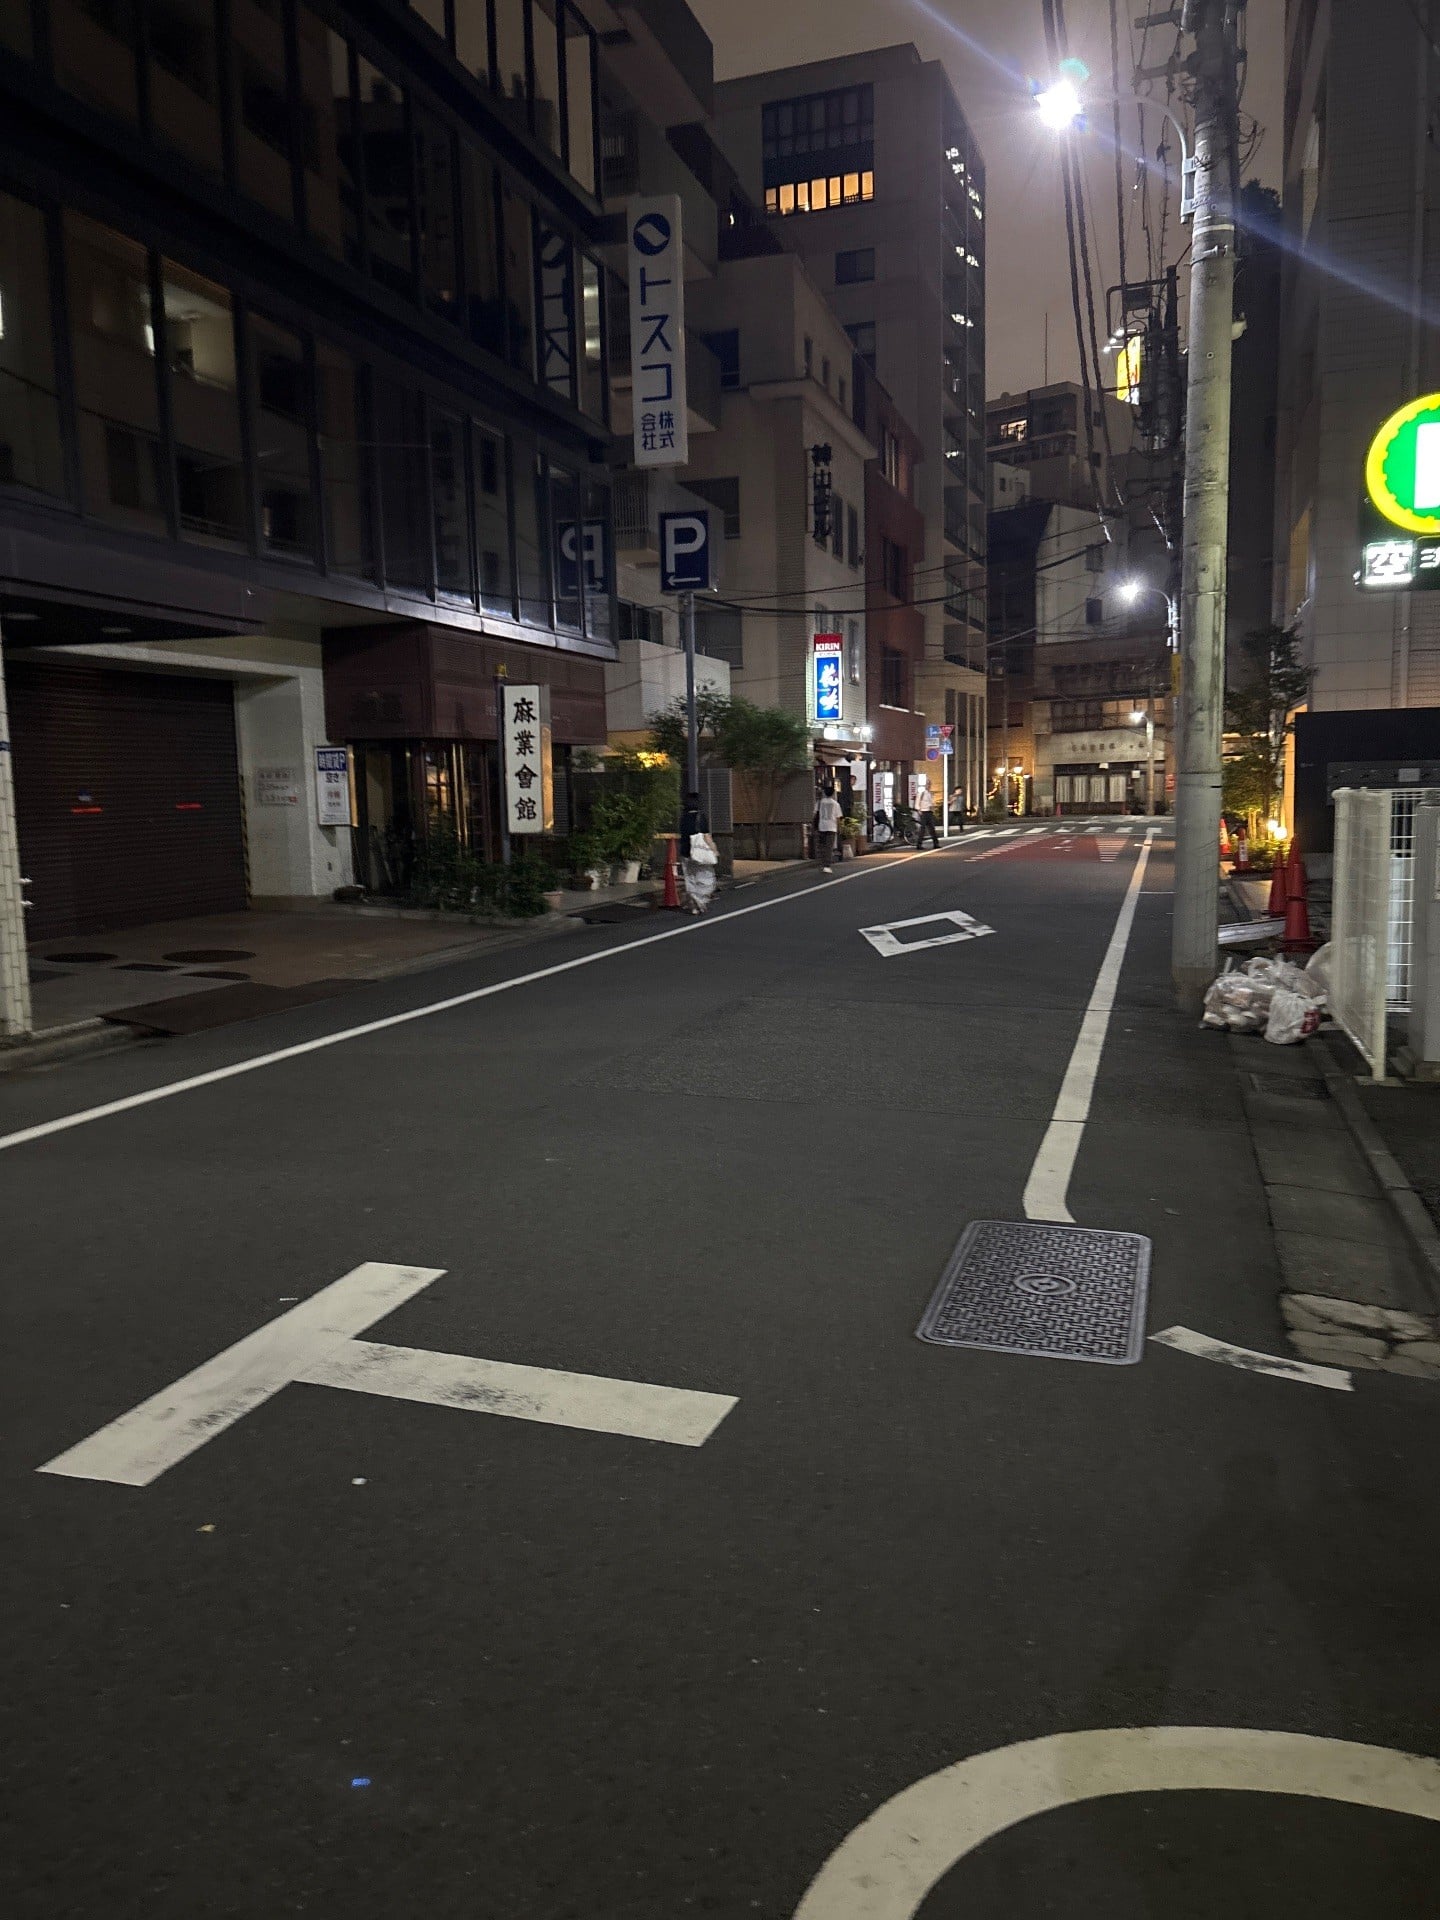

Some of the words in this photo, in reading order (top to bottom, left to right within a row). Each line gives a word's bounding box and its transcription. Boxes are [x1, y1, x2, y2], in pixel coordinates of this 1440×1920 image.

[640, 267, 672, 403] トスコ
[665, 518, 706, 572] P
[816, 643, 840, 651] KIRIN
[513, 697, 538, 821] 麻業會館
